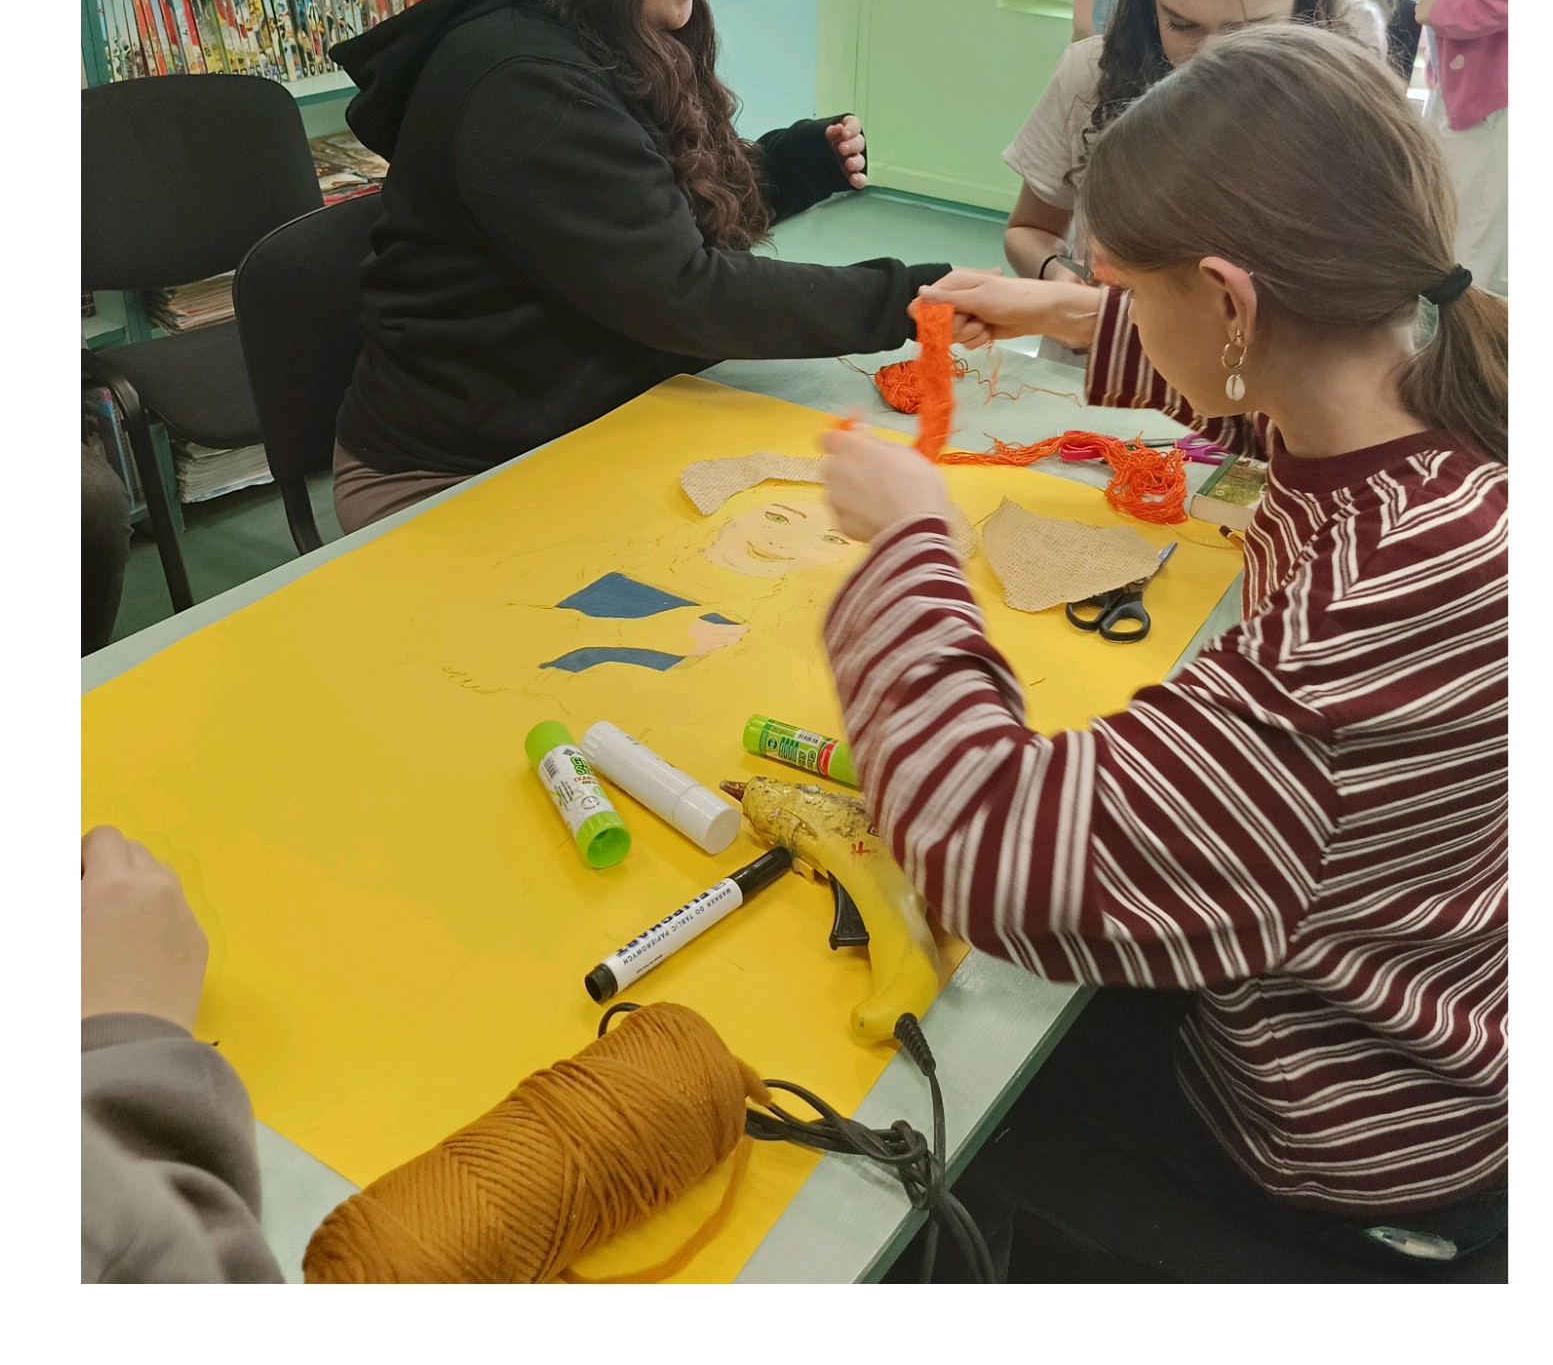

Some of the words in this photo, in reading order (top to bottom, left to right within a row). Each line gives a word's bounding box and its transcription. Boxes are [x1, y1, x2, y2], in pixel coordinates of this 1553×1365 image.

[706, 887, 732, 908] MARKER
[695, 905, 706, 915] DO
[671, 913, 694, 932] TABLIC
[622, 932, 670, 966] PAPIEROWYCH
